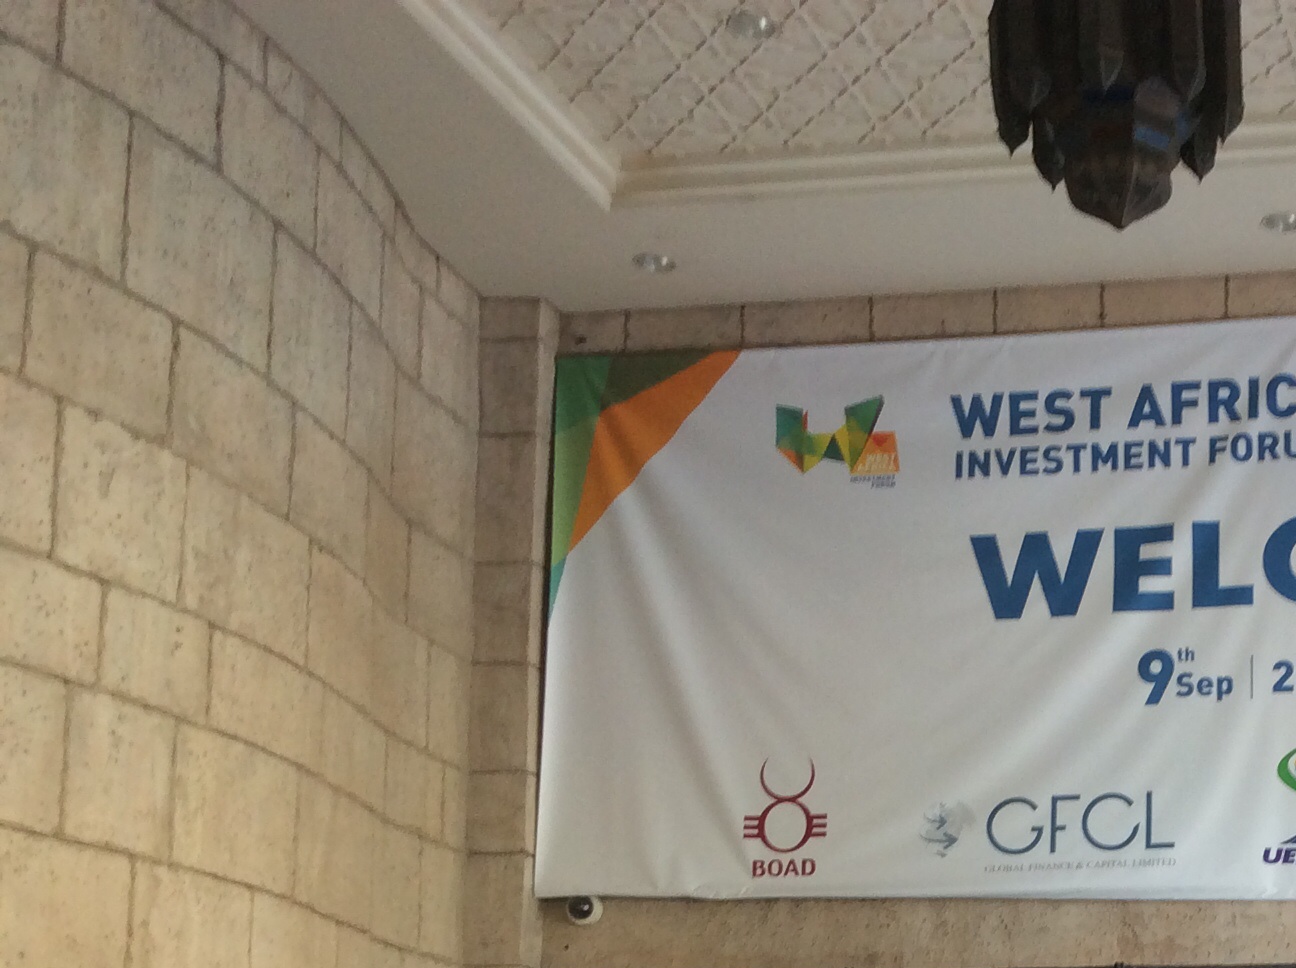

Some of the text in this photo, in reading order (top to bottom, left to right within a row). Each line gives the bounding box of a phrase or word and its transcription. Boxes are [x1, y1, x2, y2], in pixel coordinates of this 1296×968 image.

[950, 386, 1112, 439] WEST
[954, 436, 1197, 480] INVESTMENT
[1175, 671, 1234, 702] Sep
[986, 790, 1175, 854] GFCL
[752, 858, 816, 877] BOAD
[1028, 861, 1075, 872] FINANCE
[1086, 859, 1127, 869] CAPITAL
[1132, 857, 1176, 868] LIMITED
